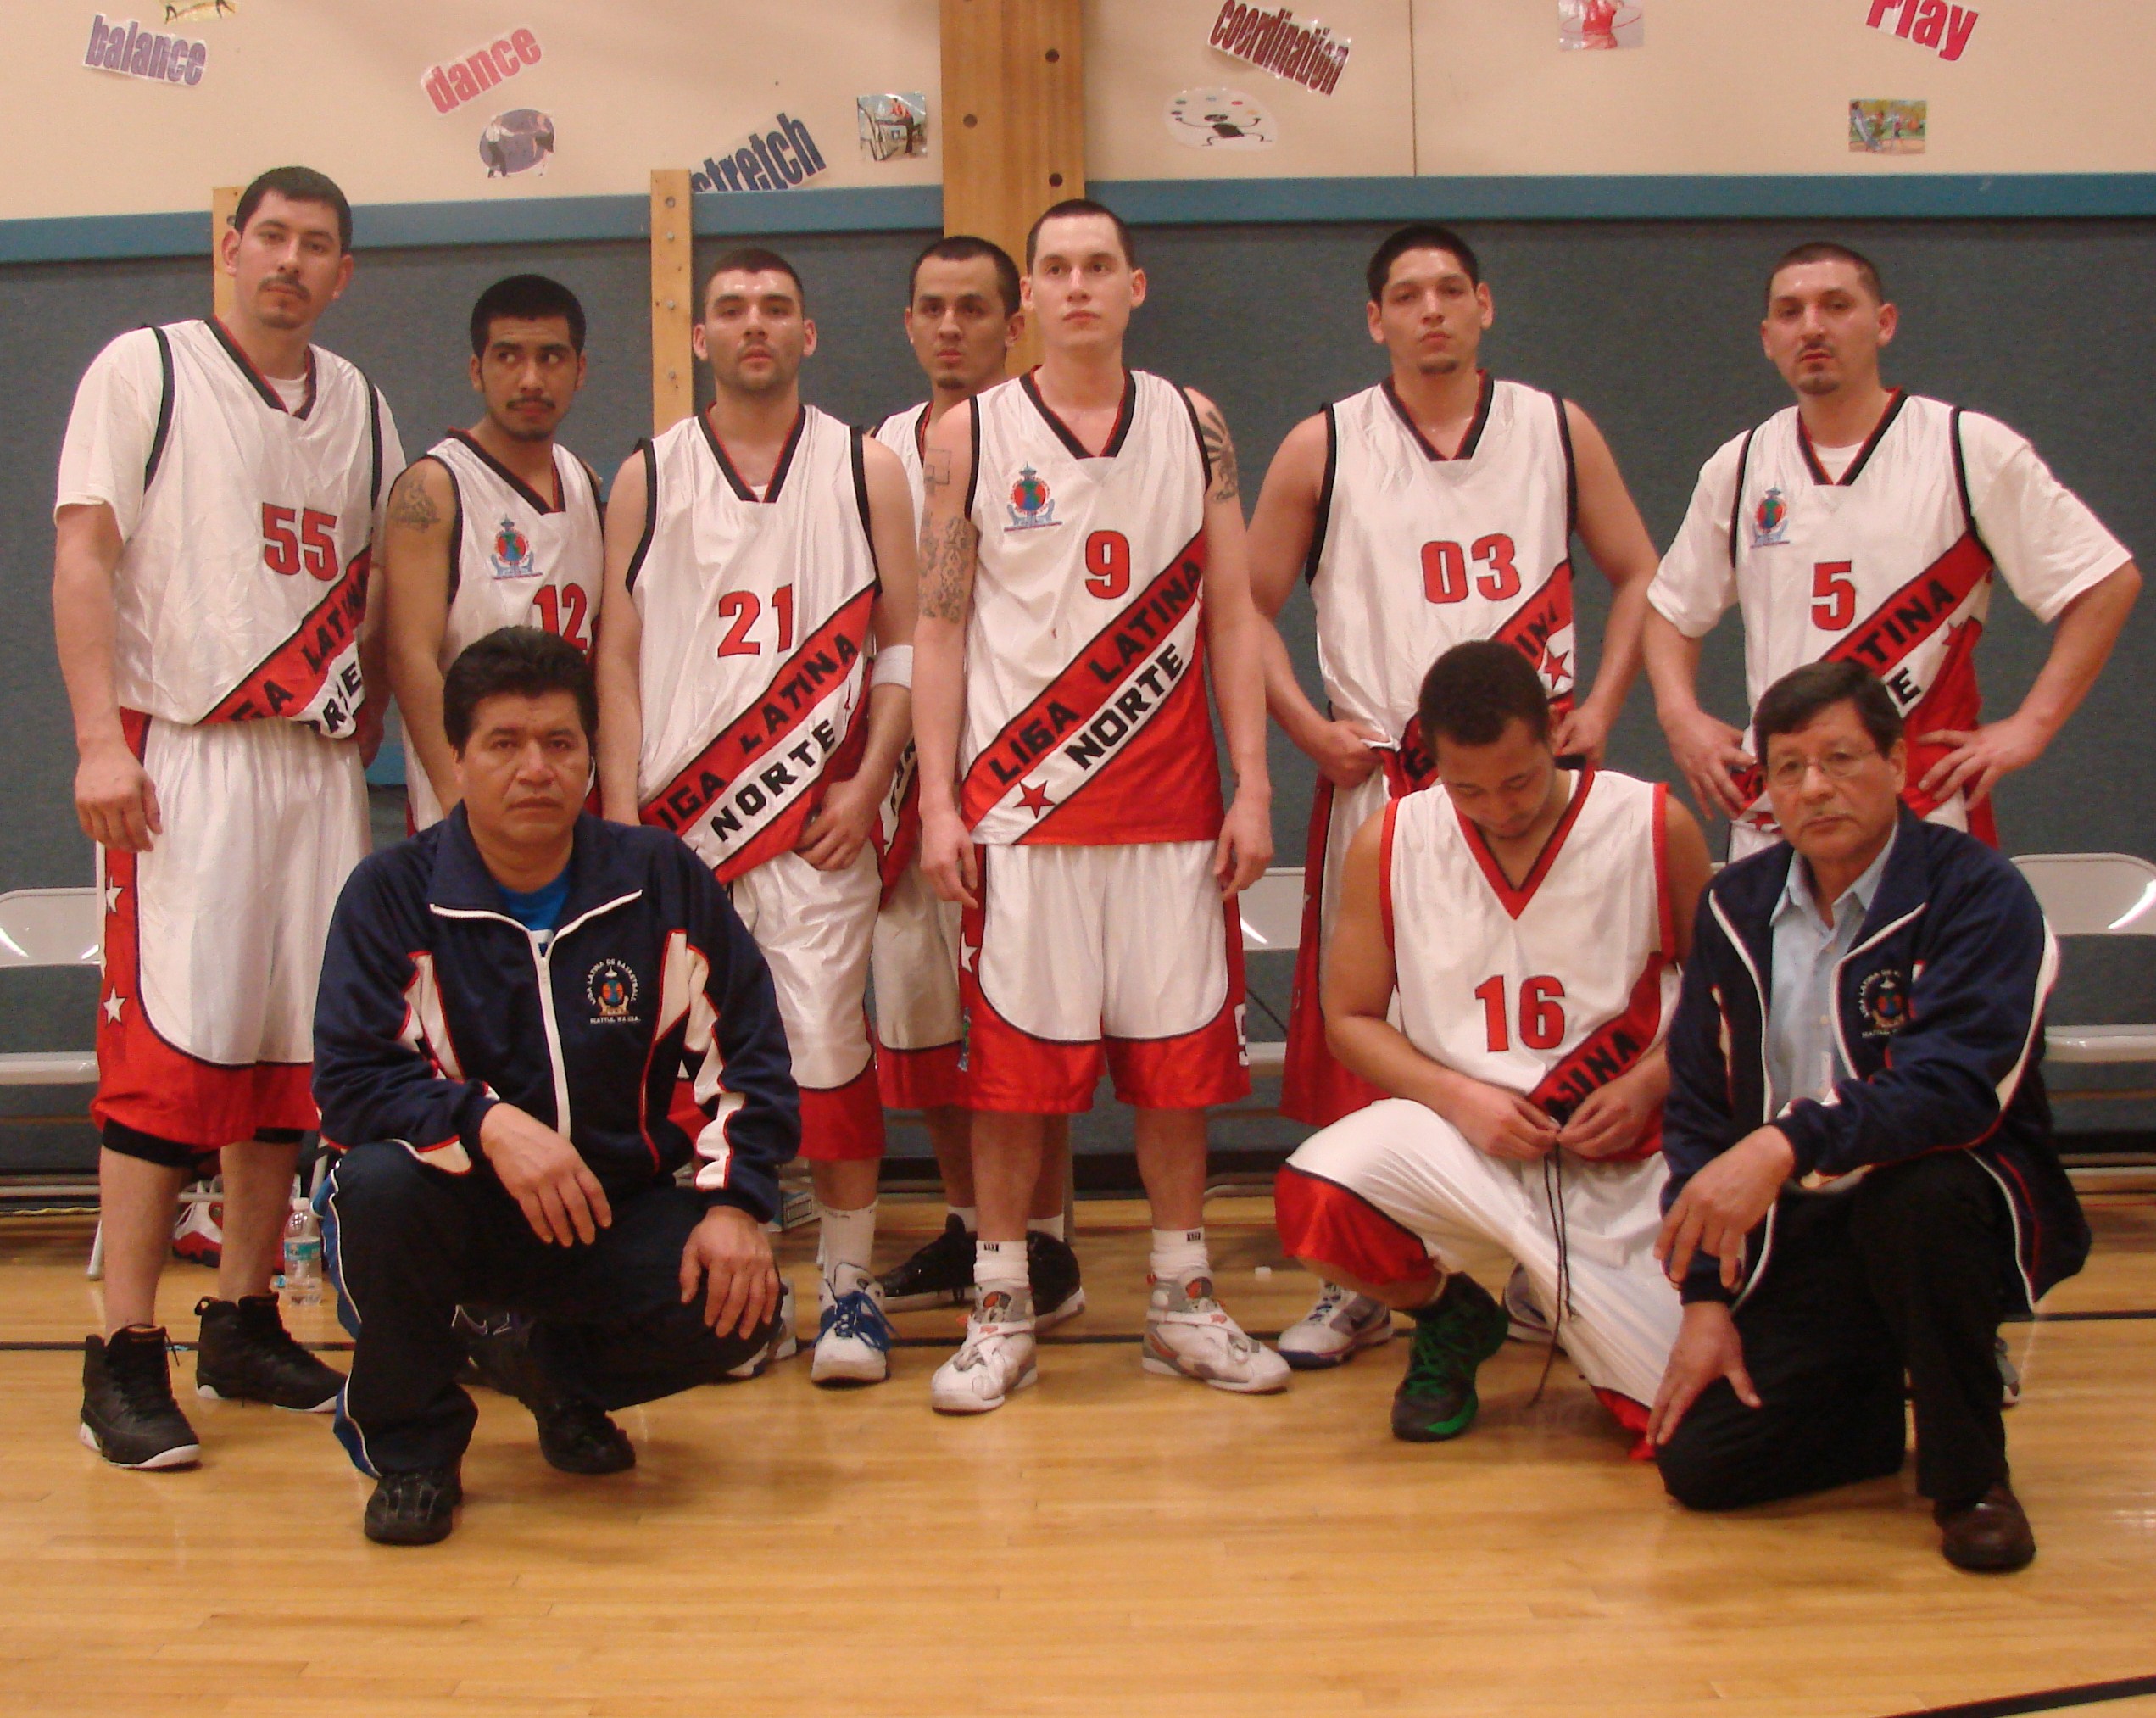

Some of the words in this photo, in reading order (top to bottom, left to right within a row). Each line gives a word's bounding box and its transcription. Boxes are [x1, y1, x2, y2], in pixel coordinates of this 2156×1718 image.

[86, 14, 207, 86] balance
[1209, 0, 1349, 96] coordination
[1866, 0, 1979, 61] Play
[425, 27, 543, 114] dance
[262, 502, 338, 581] 55
[1085, 530, 1130, 600] 9
[1421, 533, 1521, 604] 03
[533, 583, 588, 650] 12
[717, 583, 793, 657] 21
[1812, 561, 1856, 631] 5
[739, 633, 859, 755] LATINA
[989, 700, 1080, 784] LIGA
[1089, 559, 1202, 684] LATINA
[1064, 644, 1184, 771] NORTE
[710, 719, 836, 842] NORTE
[1474, 975, 1565, 1052] 16
